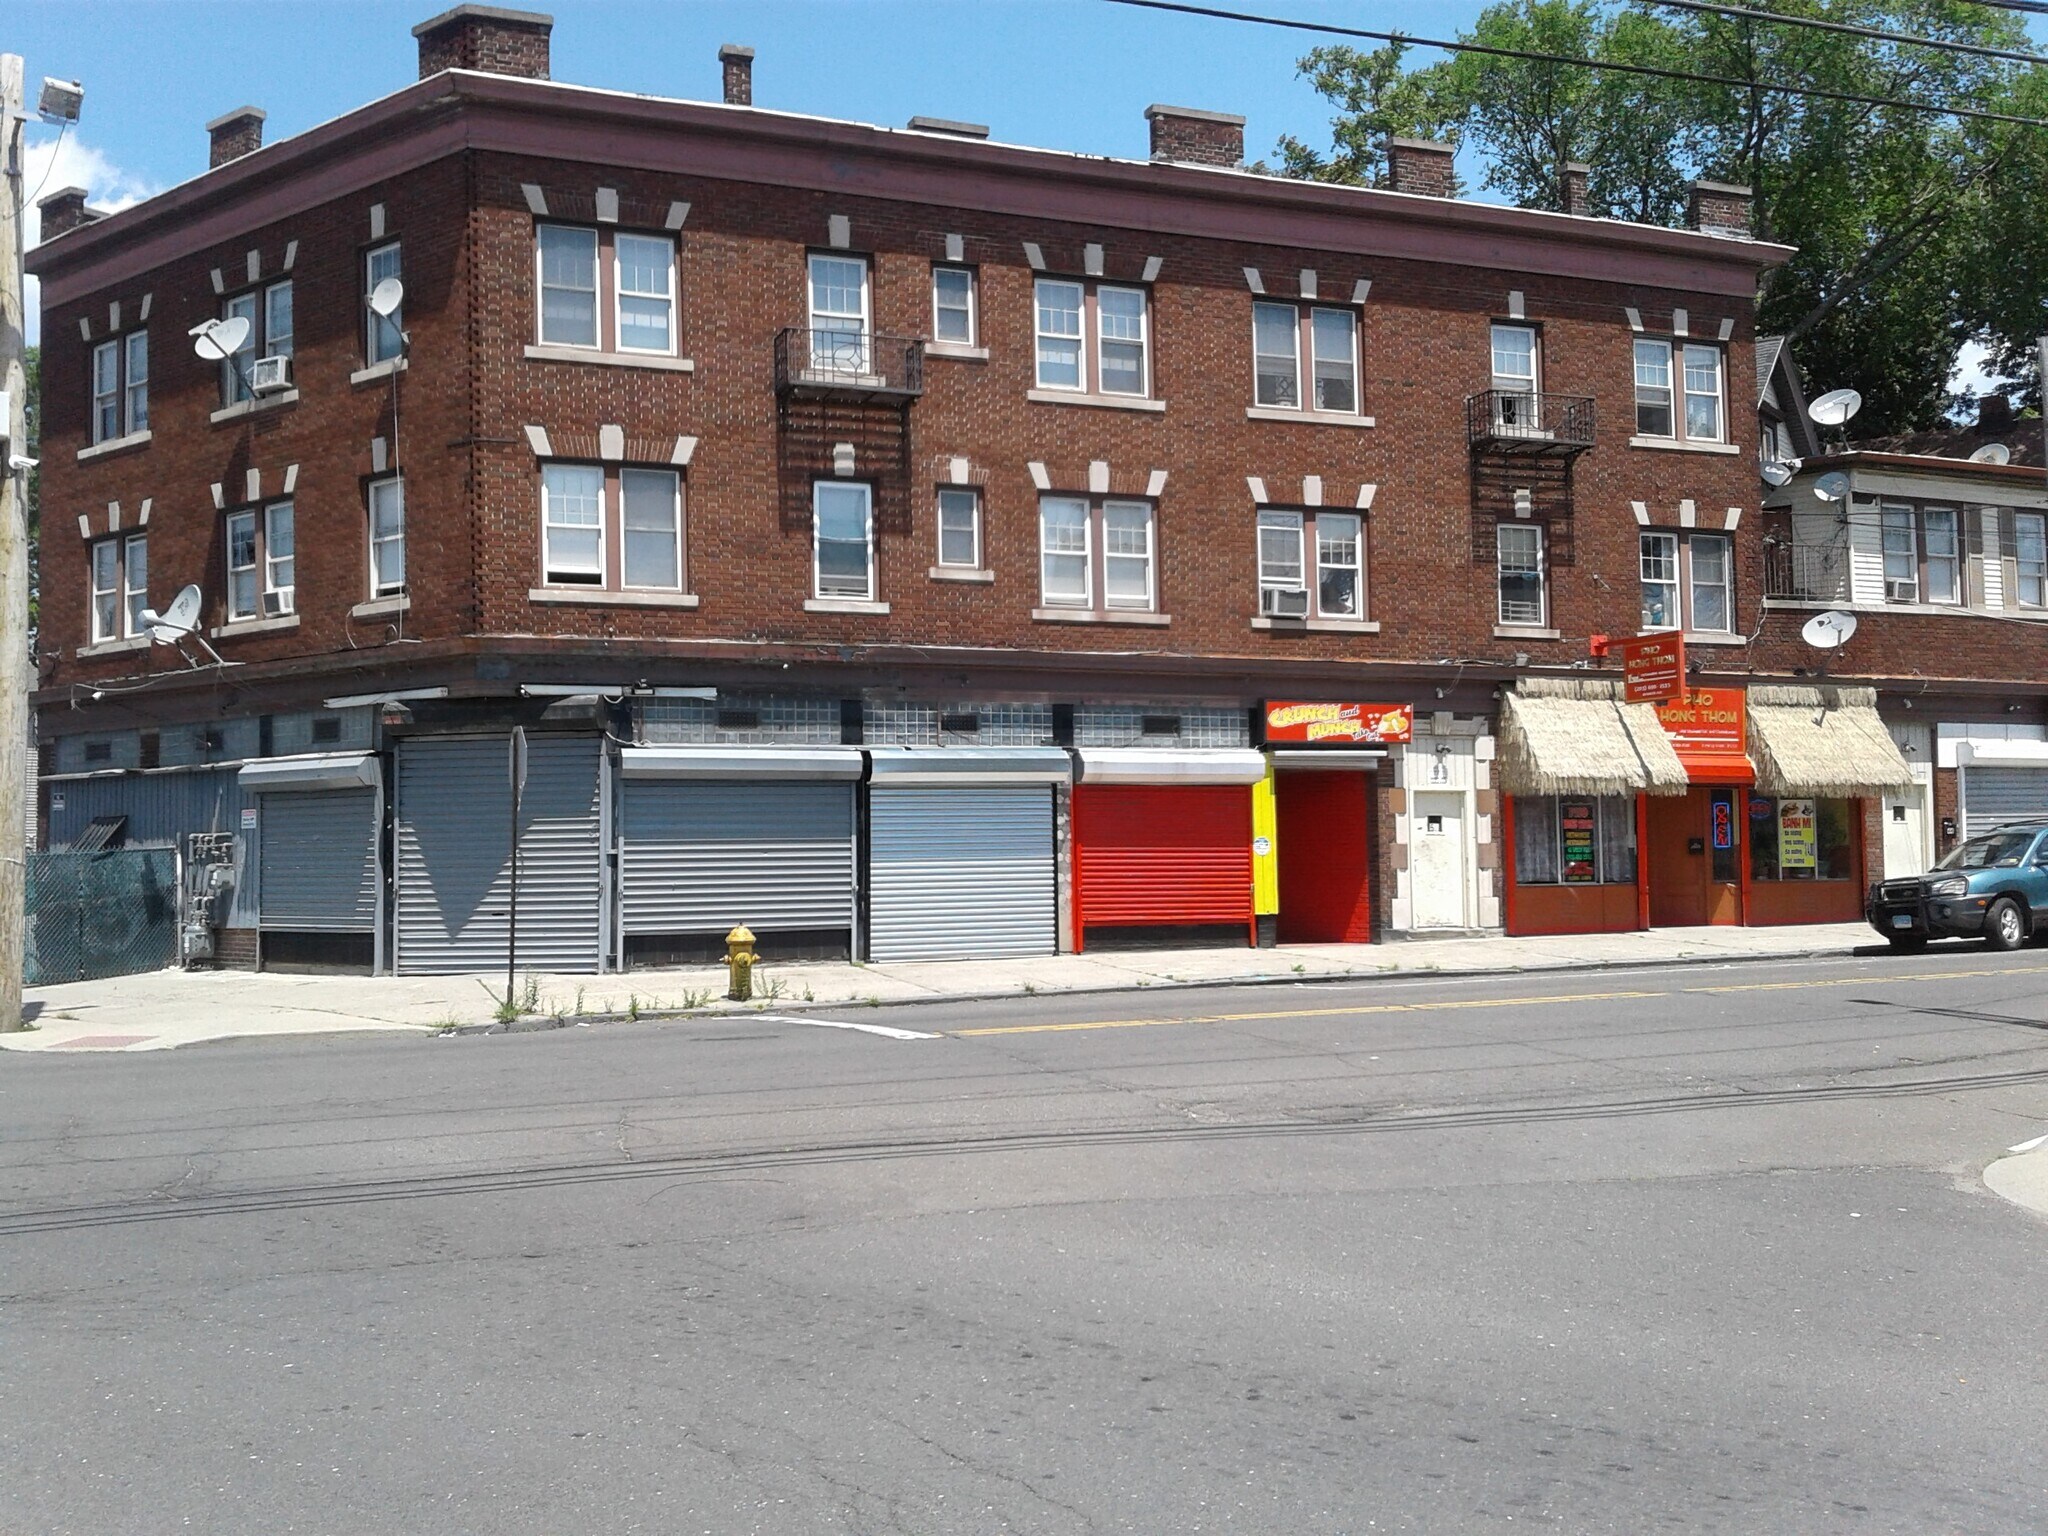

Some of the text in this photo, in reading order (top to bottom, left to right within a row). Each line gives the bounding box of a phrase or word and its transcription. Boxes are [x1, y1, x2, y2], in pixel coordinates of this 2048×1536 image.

[1628, 659, 1650, 668] HONG
[1683, 694, 1713, 706] PHO
[1269, 704, 1358, 727] CRUNCH and
[1661, 709, 1737, 723] HONG THOM
[1308, 719, 1361, 740] MUNCH
[1716, 805, 1728, 846] OPEN
